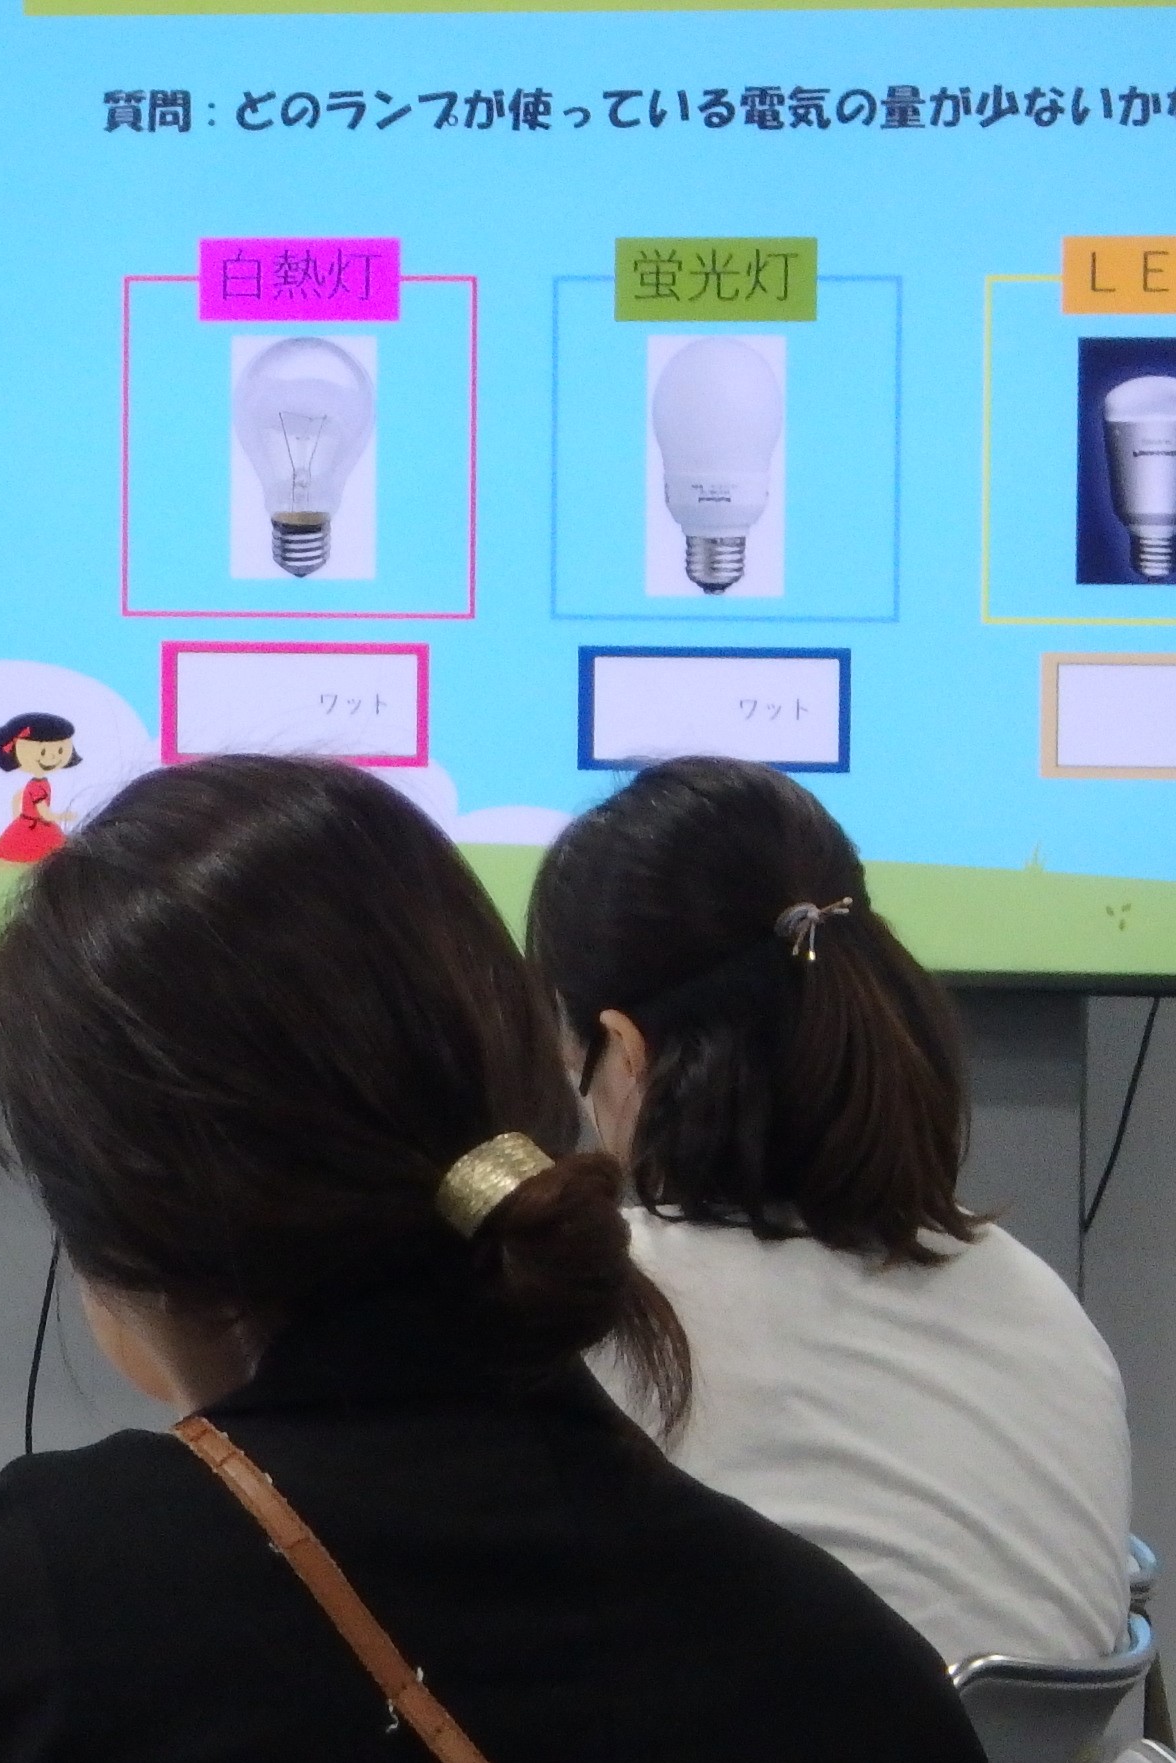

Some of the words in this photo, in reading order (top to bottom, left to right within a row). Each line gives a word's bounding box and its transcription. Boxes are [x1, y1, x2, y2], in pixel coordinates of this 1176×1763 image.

[103, 84, 1176, 133] 質問：どのランプが使っている電気の量が少ないか
[221, 248, 383, 301] 白熱灯
[632, 248, 799, 303] 蛍光灯
[318, 692, 388, 716] ワット
[738, 697, 810, 721] ワット
